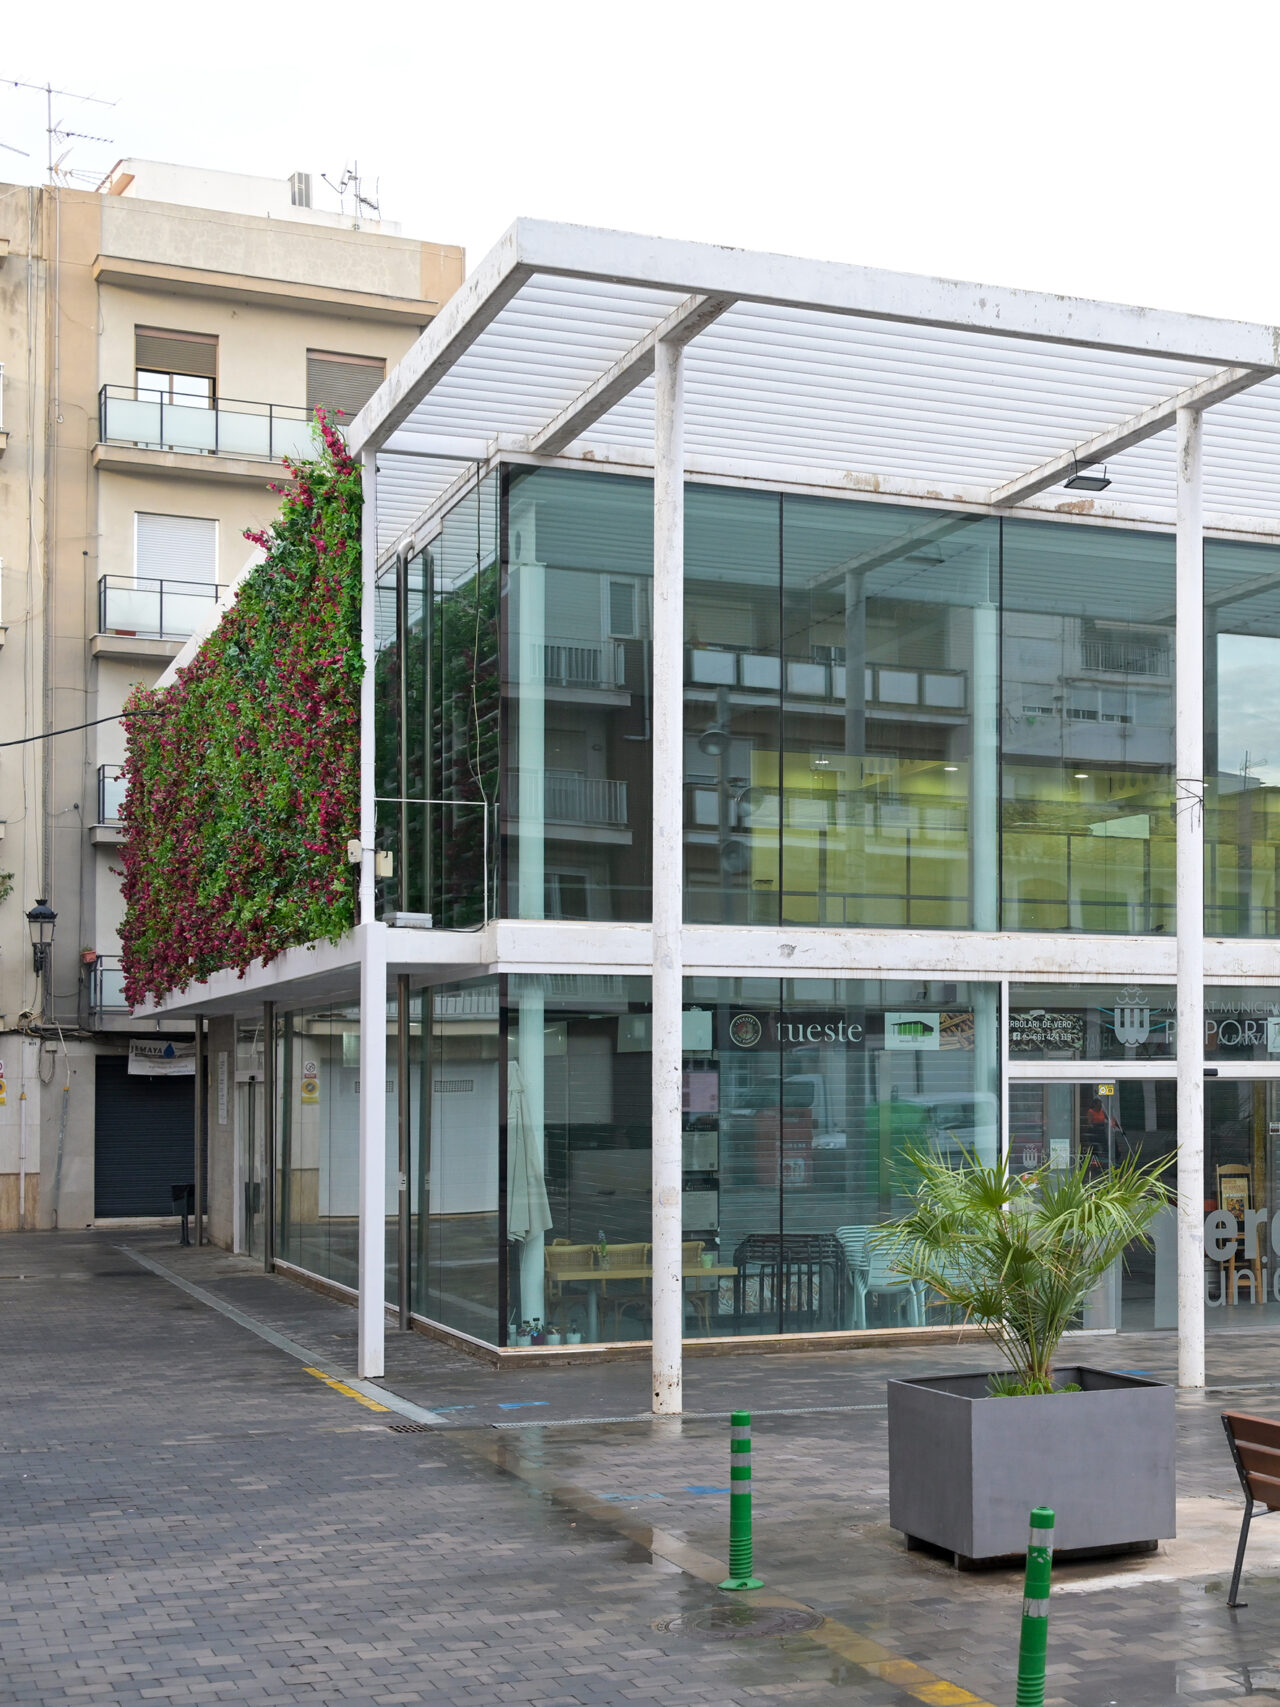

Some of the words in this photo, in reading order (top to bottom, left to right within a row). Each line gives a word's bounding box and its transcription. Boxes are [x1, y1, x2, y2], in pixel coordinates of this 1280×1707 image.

[776, 1019, 863, 1042] tueste
[1009, 1020, 1039, 1028] RBOLARI
[1042, 1020, 1051, 1028] DE
[1054, 1020, 1072, 1028] VERO
